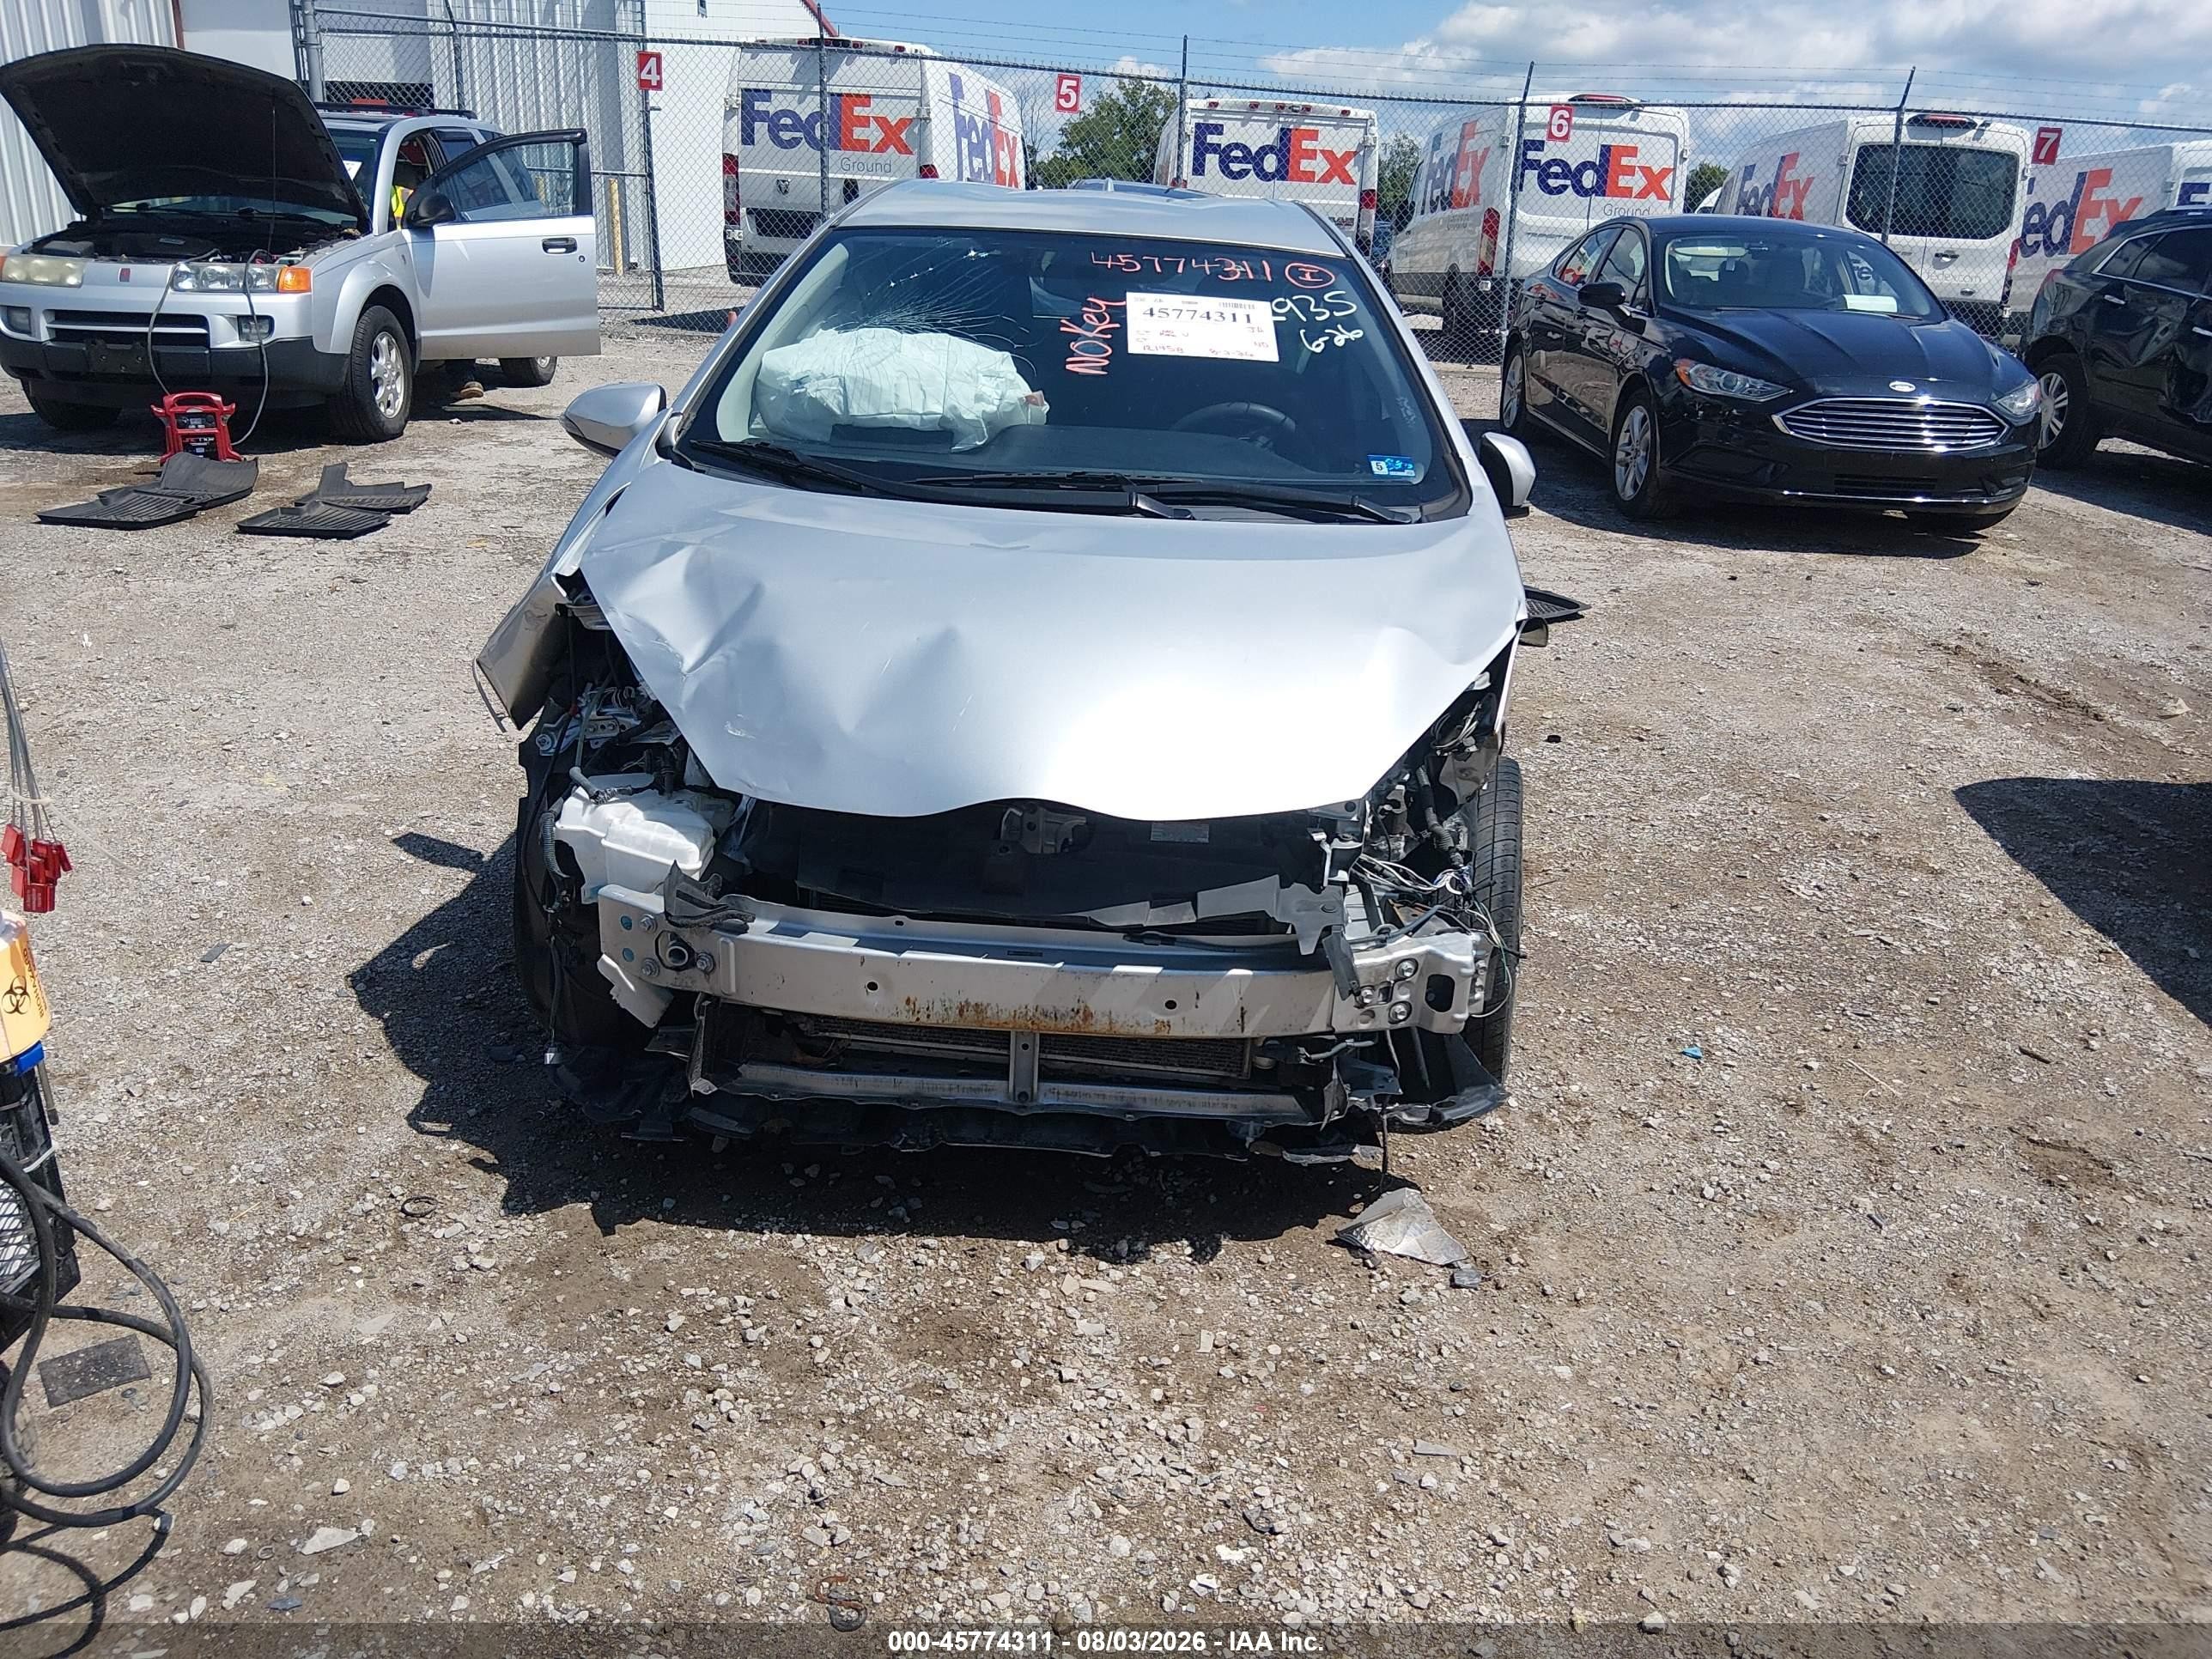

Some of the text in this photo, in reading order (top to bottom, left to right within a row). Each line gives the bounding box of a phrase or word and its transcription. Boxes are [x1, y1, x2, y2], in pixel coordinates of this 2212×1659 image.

[639, 57, 661, 86] 4
[1058, 78, 1079, 109] 5
[741, 88, 915, 155] FedEx
[949, 72, 1019, 189] FedEx
[1550, 109, 1569, 138] 6
[1192, 122, 1359, 185] FedEx
[2037, 131, 2059, 160] 7
[840, 156, 892, 174] Ground
[1421, 120, 1491, 216] FedEx
[1518, 138, 1676, 201] FedEx
[1735, 151, 1814, 220] FedEx
[1603, 203, 1650, 216] Ground
[2017, 167, 2143, 258] edEx
[1091, 252, 1272, 282] 45774311
[1142, 307, 1252, 325] 45774311
